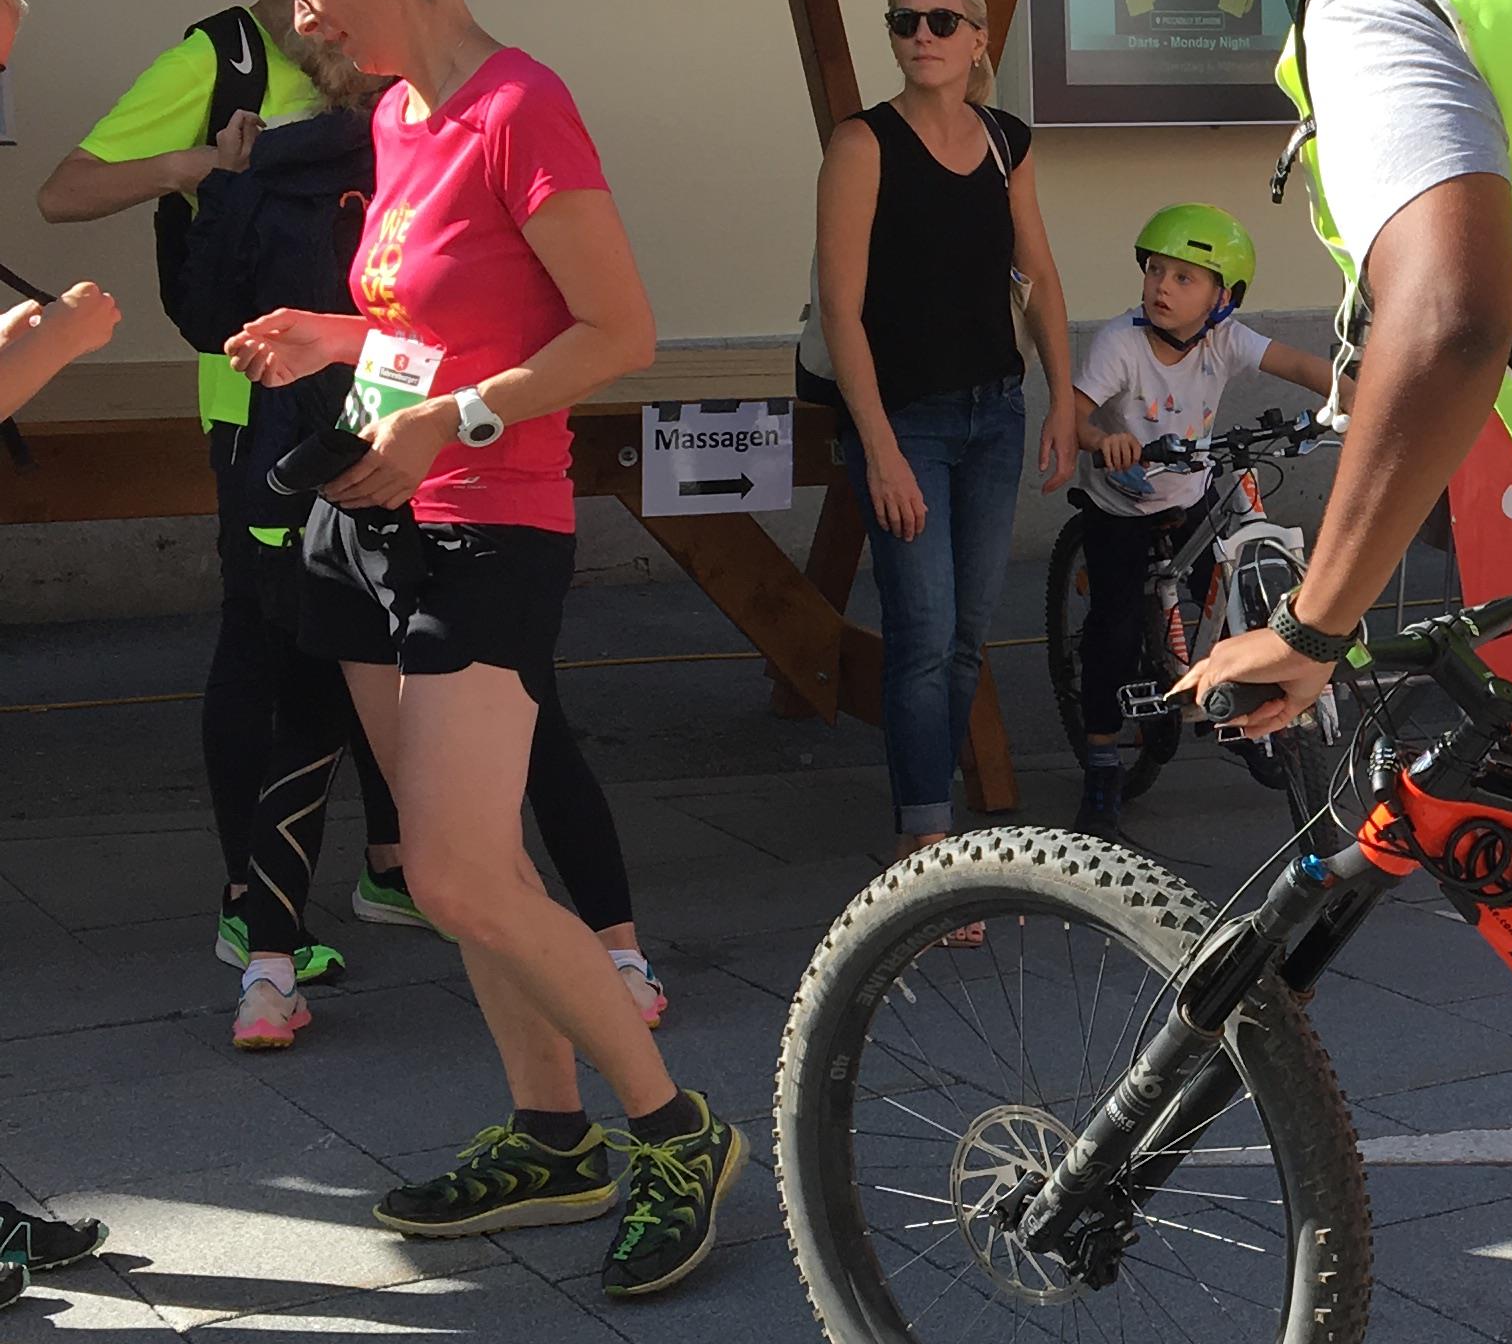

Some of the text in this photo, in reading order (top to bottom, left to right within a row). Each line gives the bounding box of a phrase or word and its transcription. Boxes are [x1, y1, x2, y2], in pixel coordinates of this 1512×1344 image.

[1128, 36, 1160, 49] Darts
[1170, 36, 1217, 51] Monday
[1219, 36, 1251, 51] Night
[655, 428, 779, 453] Massagen
[1130, 1054, 1165, 1099] 36
